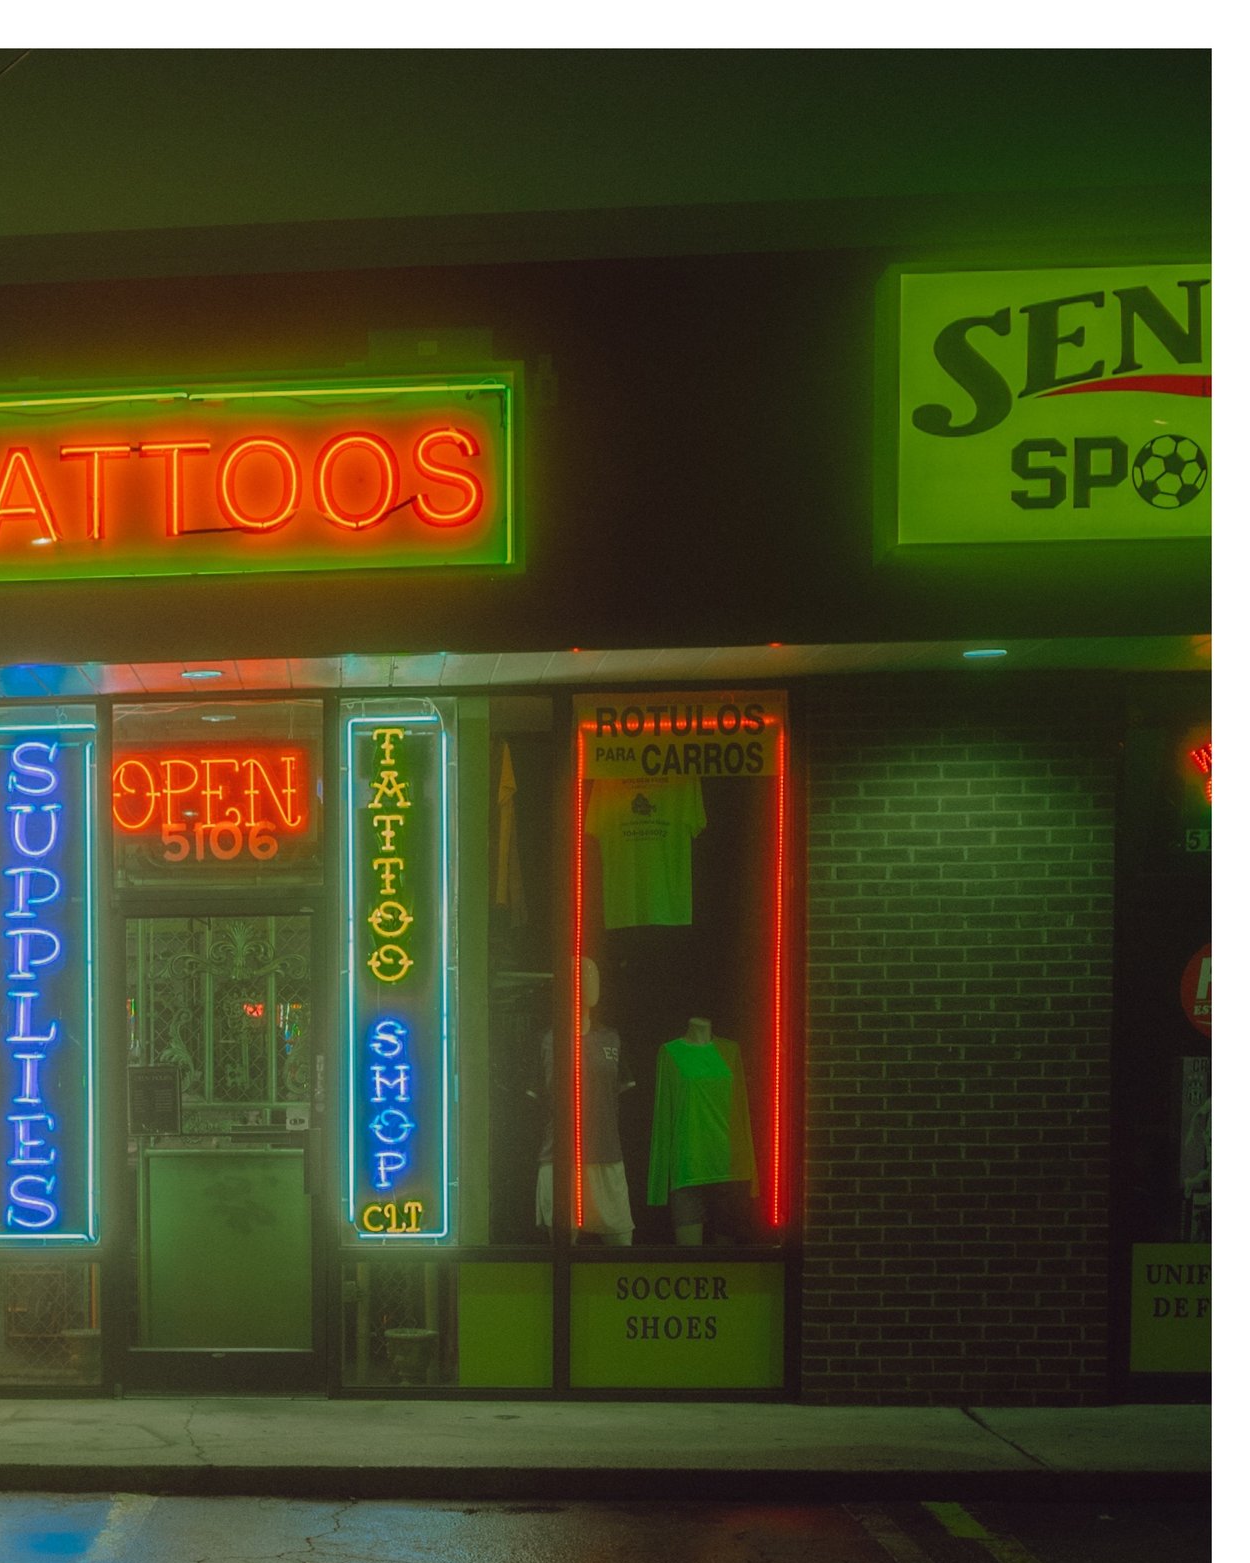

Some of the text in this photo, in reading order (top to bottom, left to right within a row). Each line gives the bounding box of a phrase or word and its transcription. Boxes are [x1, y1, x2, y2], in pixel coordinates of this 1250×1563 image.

[596, 703, 766, 738] ROTULOS
[596, 741, 764, 776] PARA CARROS
[113, 755, 302, 829] OPEN
[163, 822, 279, 861] 5106
[367, 727, 414, 1188] TATTOO SHOP
[5, 741, 62, 1229] SUPPLIES
[362, 1201, 424, 1234] CLT
[616, 1276, 729, 1300] SOCCER
[1153, 1297, 1189, 1317] DE
[626, 1316, 717, 1339] SHOES
